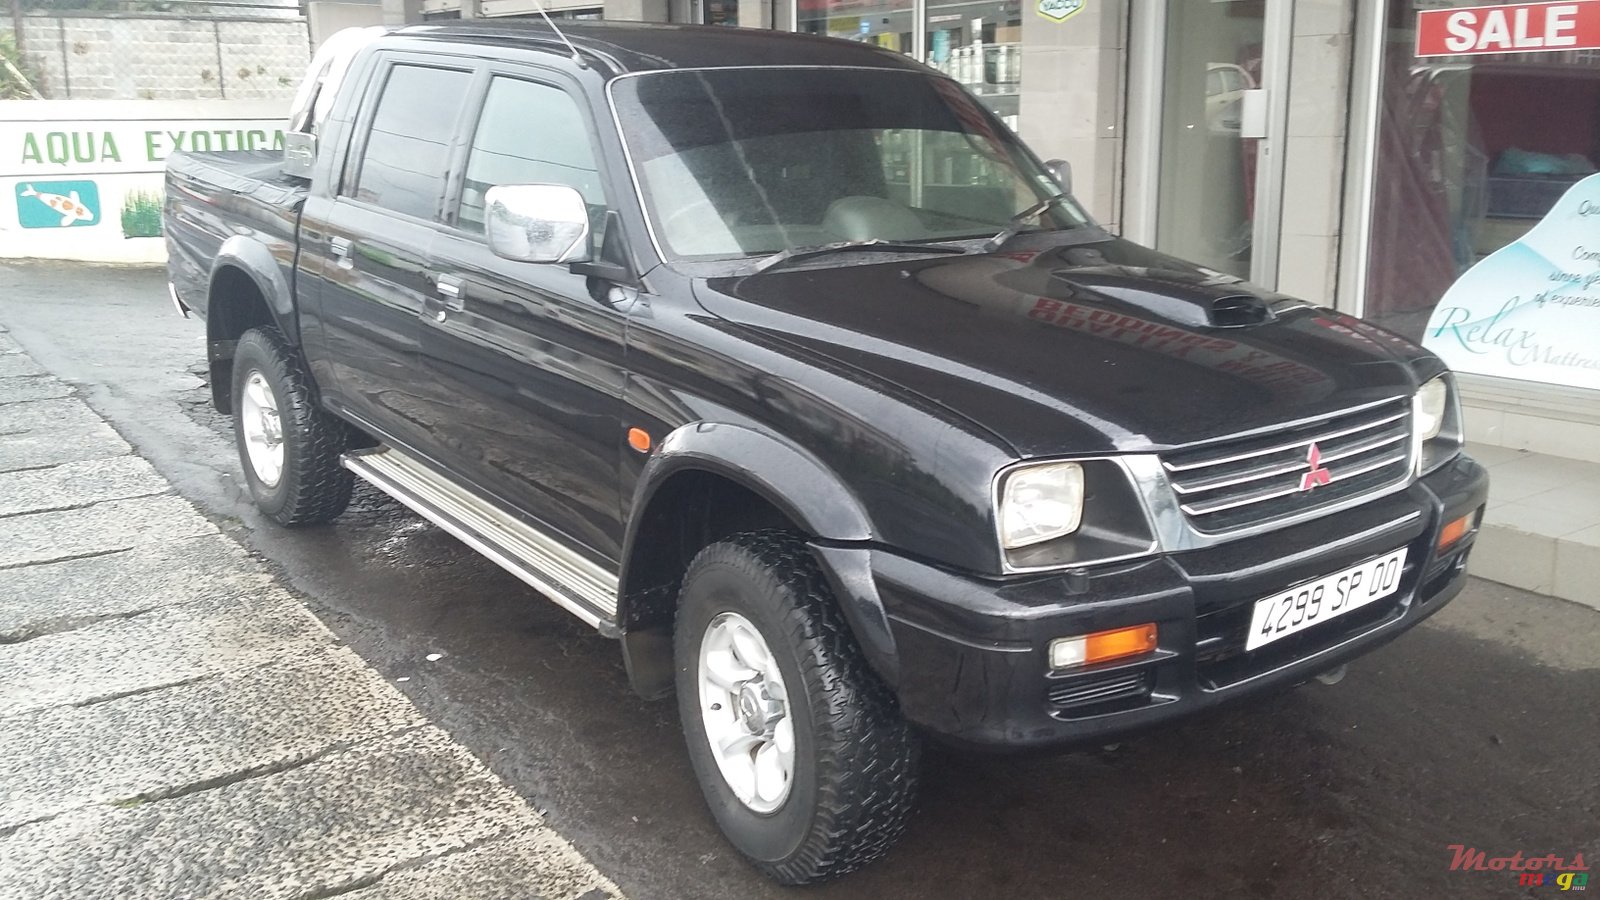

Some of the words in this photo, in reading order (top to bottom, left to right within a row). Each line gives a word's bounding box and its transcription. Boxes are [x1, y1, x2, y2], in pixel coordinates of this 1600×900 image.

[1445, 5, 1579, 52] SALE
[21, 131, 122, 166] AQUA
[145, 129, 287, 162] EXOTICA
[1534, 291, 1549, 308] of
[1434, 296, 1536, 355] Relax
[1261, 585, 1325, 637] 4299
[1332, 571, 1363, 611] SP
